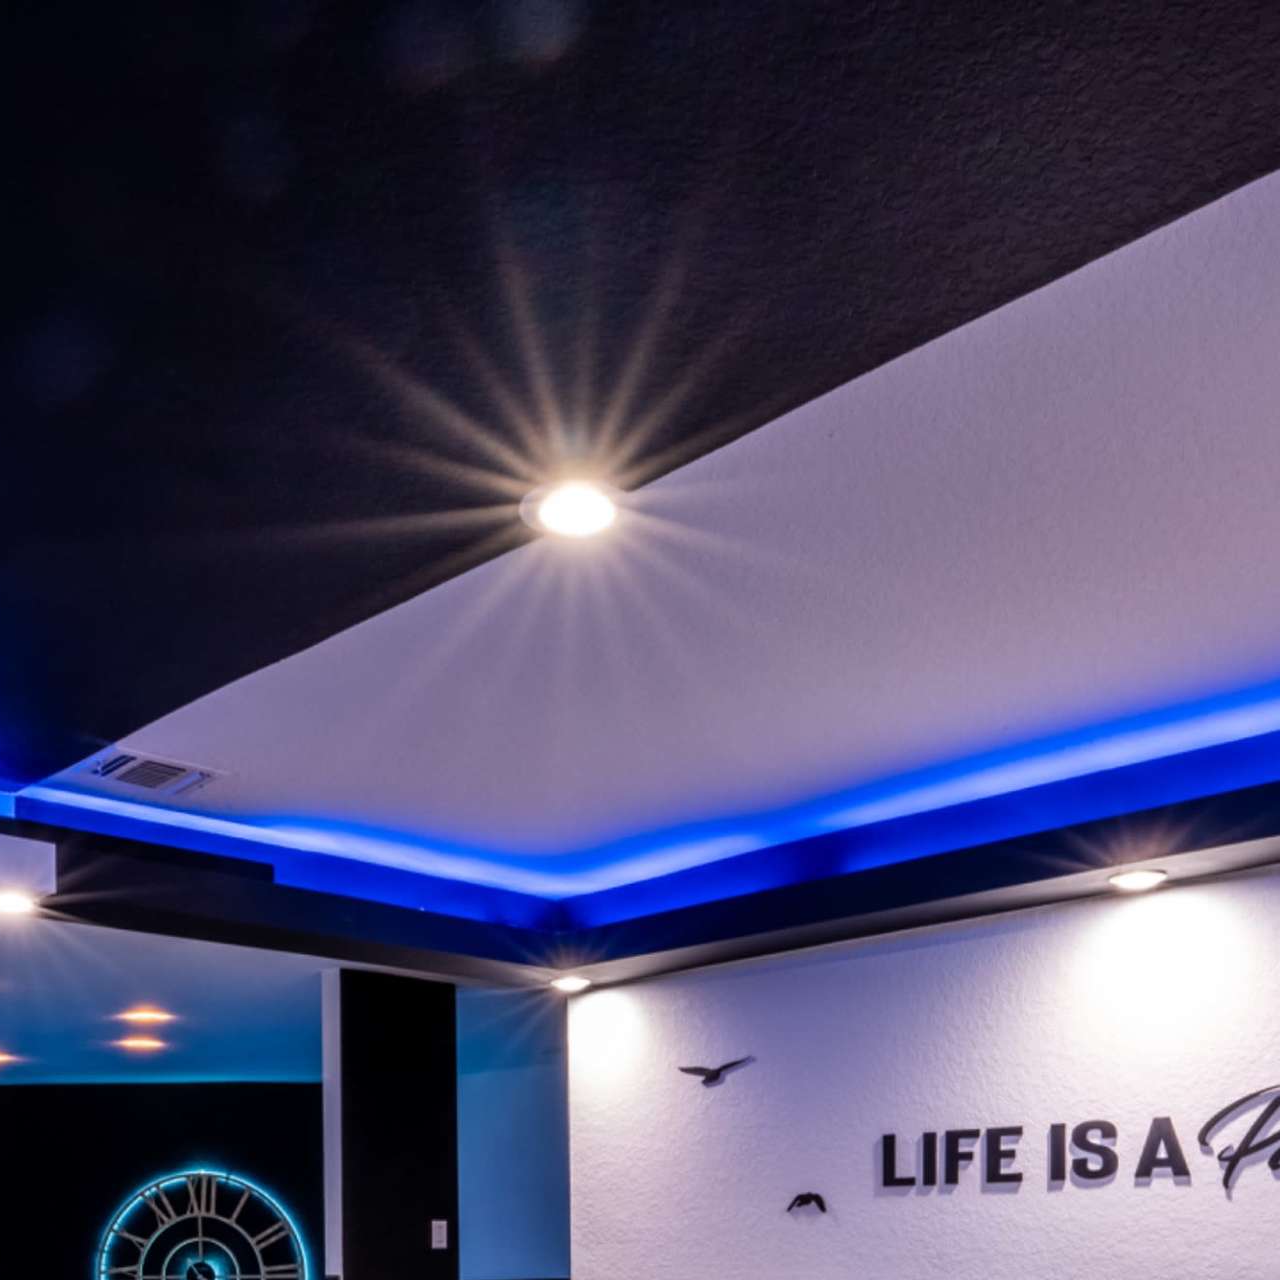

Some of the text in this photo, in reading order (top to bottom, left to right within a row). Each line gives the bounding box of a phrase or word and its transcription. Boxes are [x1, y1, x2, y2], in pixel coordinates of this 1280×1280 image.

[882, 1125, 1023, 1188] LIFE
[1050, 1120, 1119, 1183] IS
[1134, 1117, 1192, 1179] A
